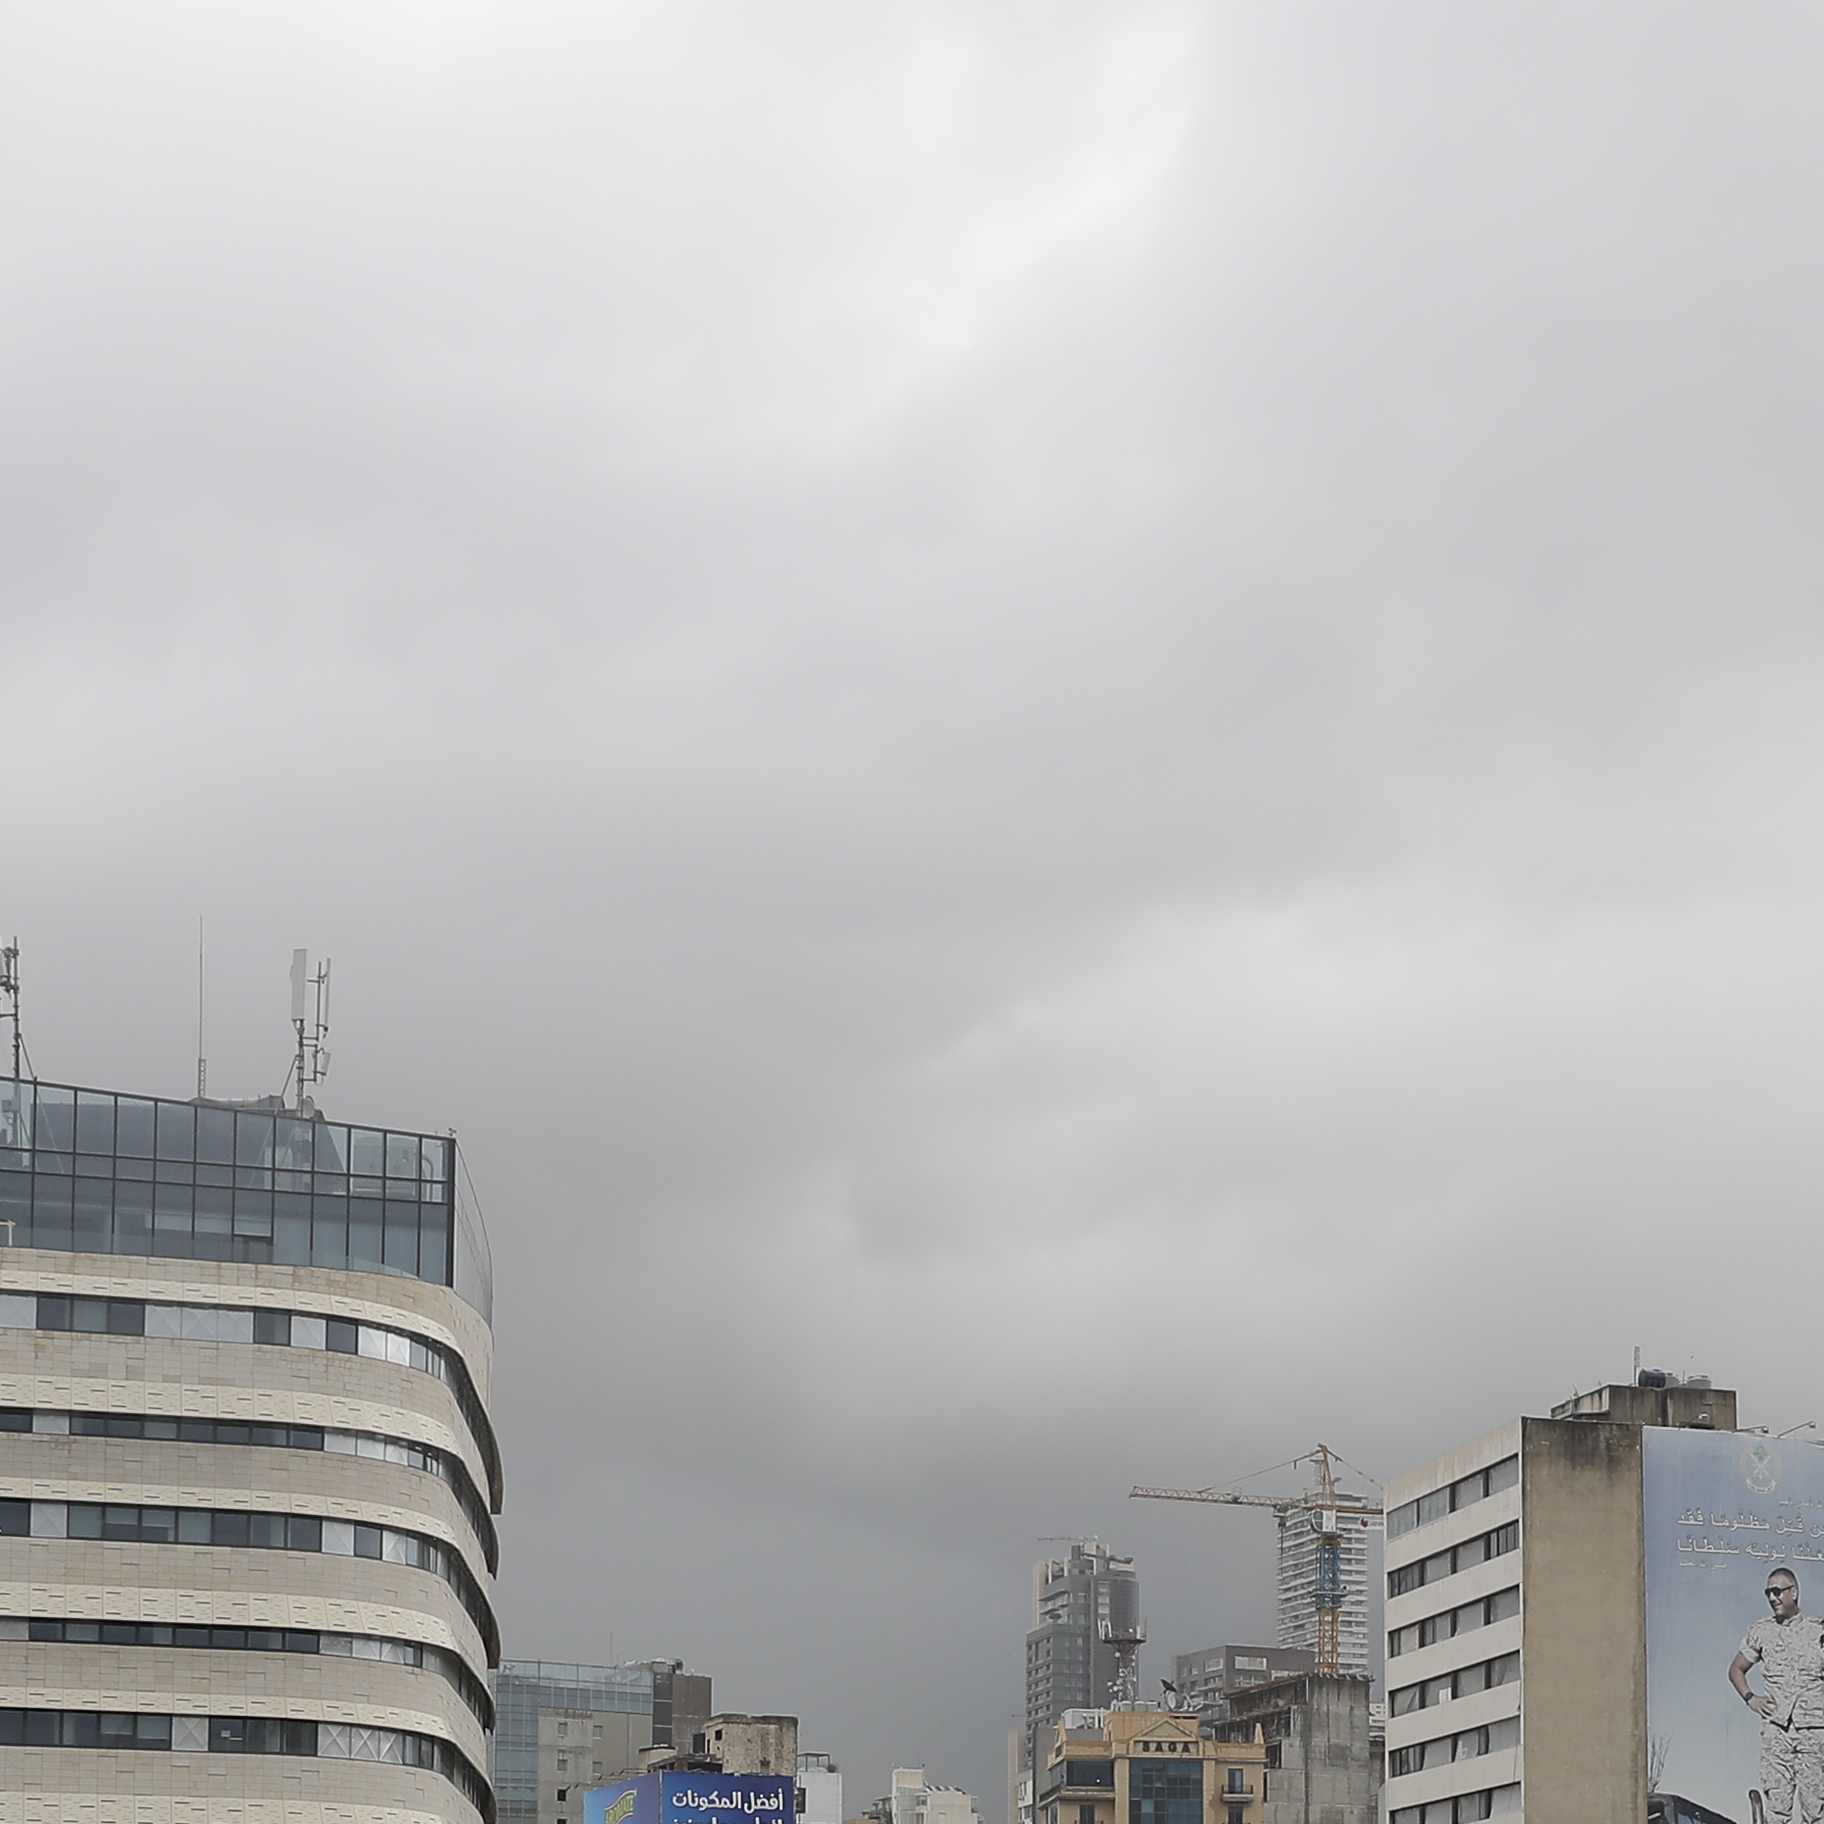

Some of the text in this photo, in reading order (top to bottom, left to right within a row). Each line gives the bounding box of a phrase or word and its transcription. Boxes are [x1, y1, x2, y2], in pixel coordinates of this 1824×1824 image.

[1142, 1742, 1191, 1753] SAGA
[671, 1787, 784, 1814] أفضل المكونات
